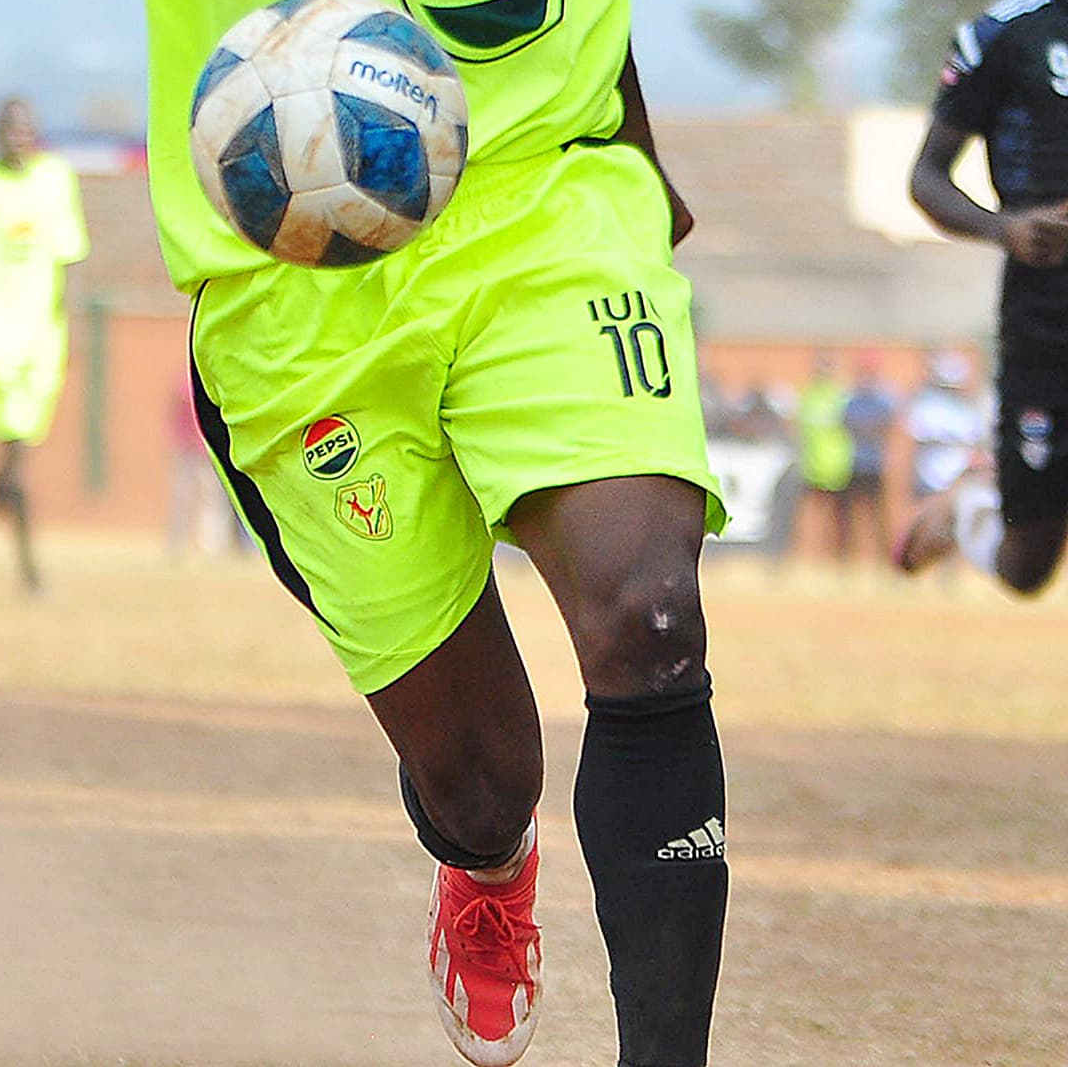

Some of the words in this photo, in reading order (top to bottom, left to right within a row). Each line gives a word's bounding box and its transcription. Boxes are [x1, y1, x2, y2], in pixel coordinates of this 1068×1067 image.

[350, 60, 437, 123] molten
[587, 291, 663, 321] IUI
[600, 322, 671, 398] 10
[306, 431, 354, 464] PEPSI
